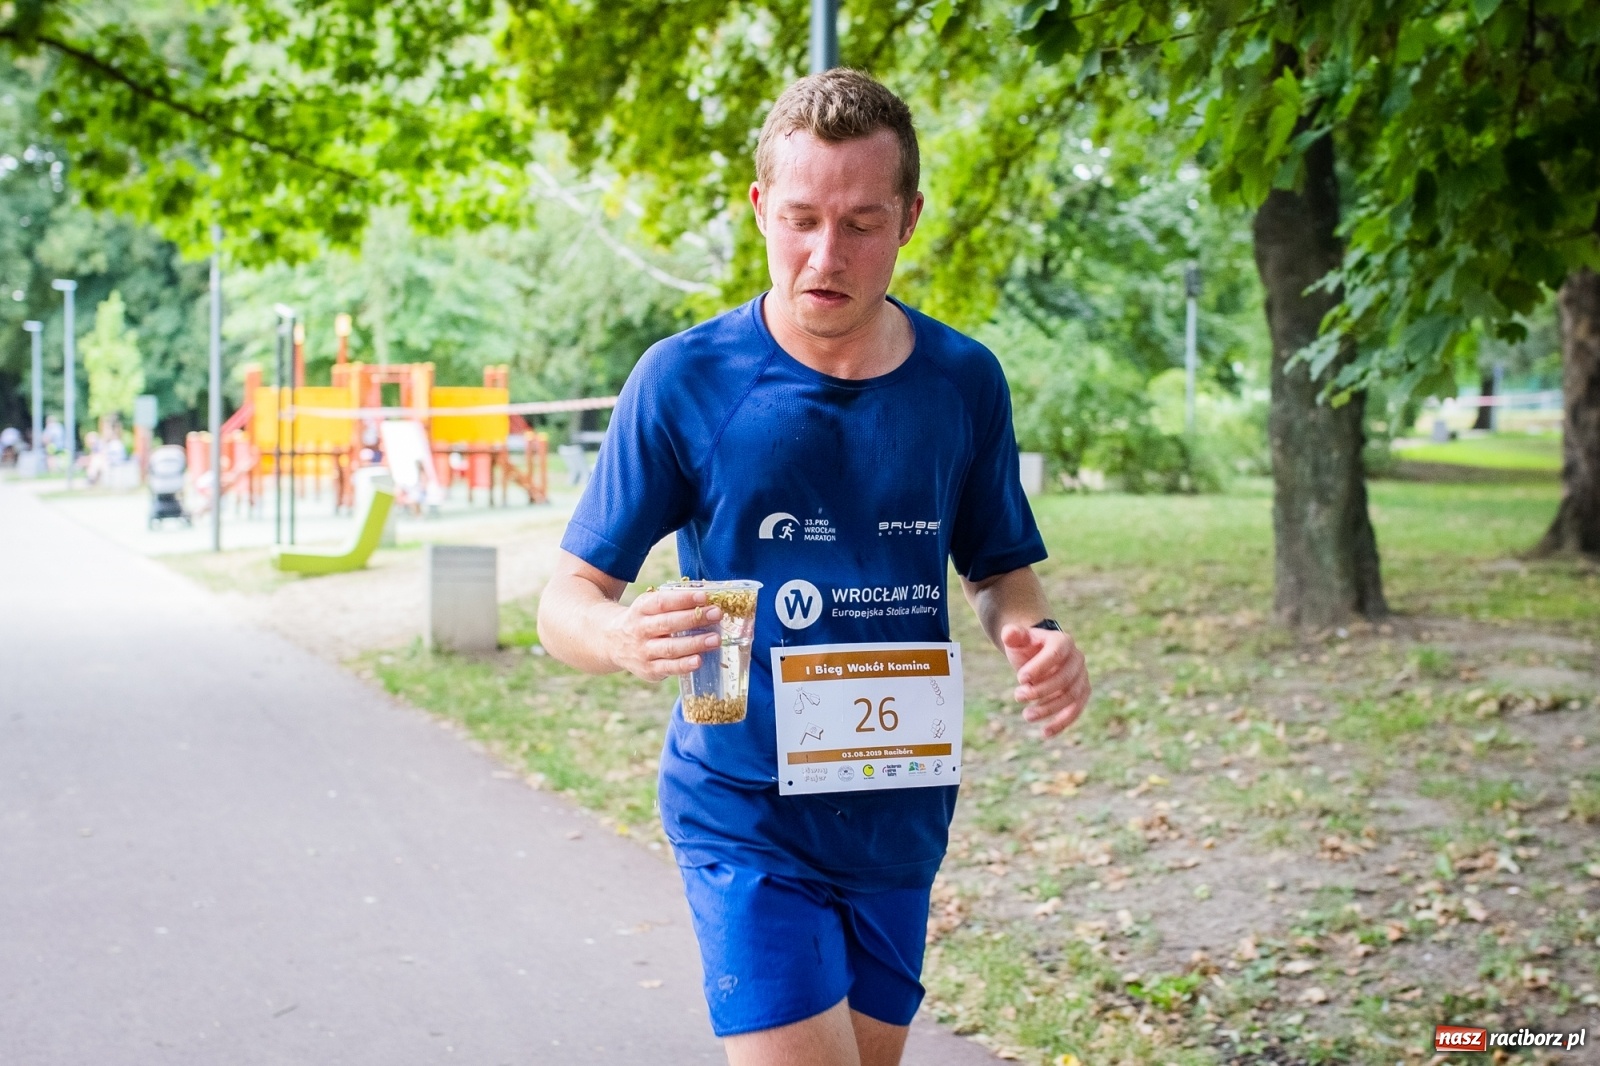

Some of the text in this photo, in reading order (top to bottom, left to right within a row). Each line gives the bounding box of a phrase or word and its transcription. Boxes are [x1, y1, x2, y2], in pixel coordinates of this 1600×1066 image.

[878, 519, 942, 530] BRUBE
[803, 534, 836, 542] MARATON
[831, 584, 940, 603] WROCŁAW 2016
[832, 604, 938, 619] Europejska Stolica Kultury
[815, 663, 843, 676] Bieg
[847, 661, 885, 673] Wokół
[888, 660, 930, 671] Komina
[853, 696, 899, 733] 26
[841, 748, 914, 758] 03.08.2019 Racibórz
